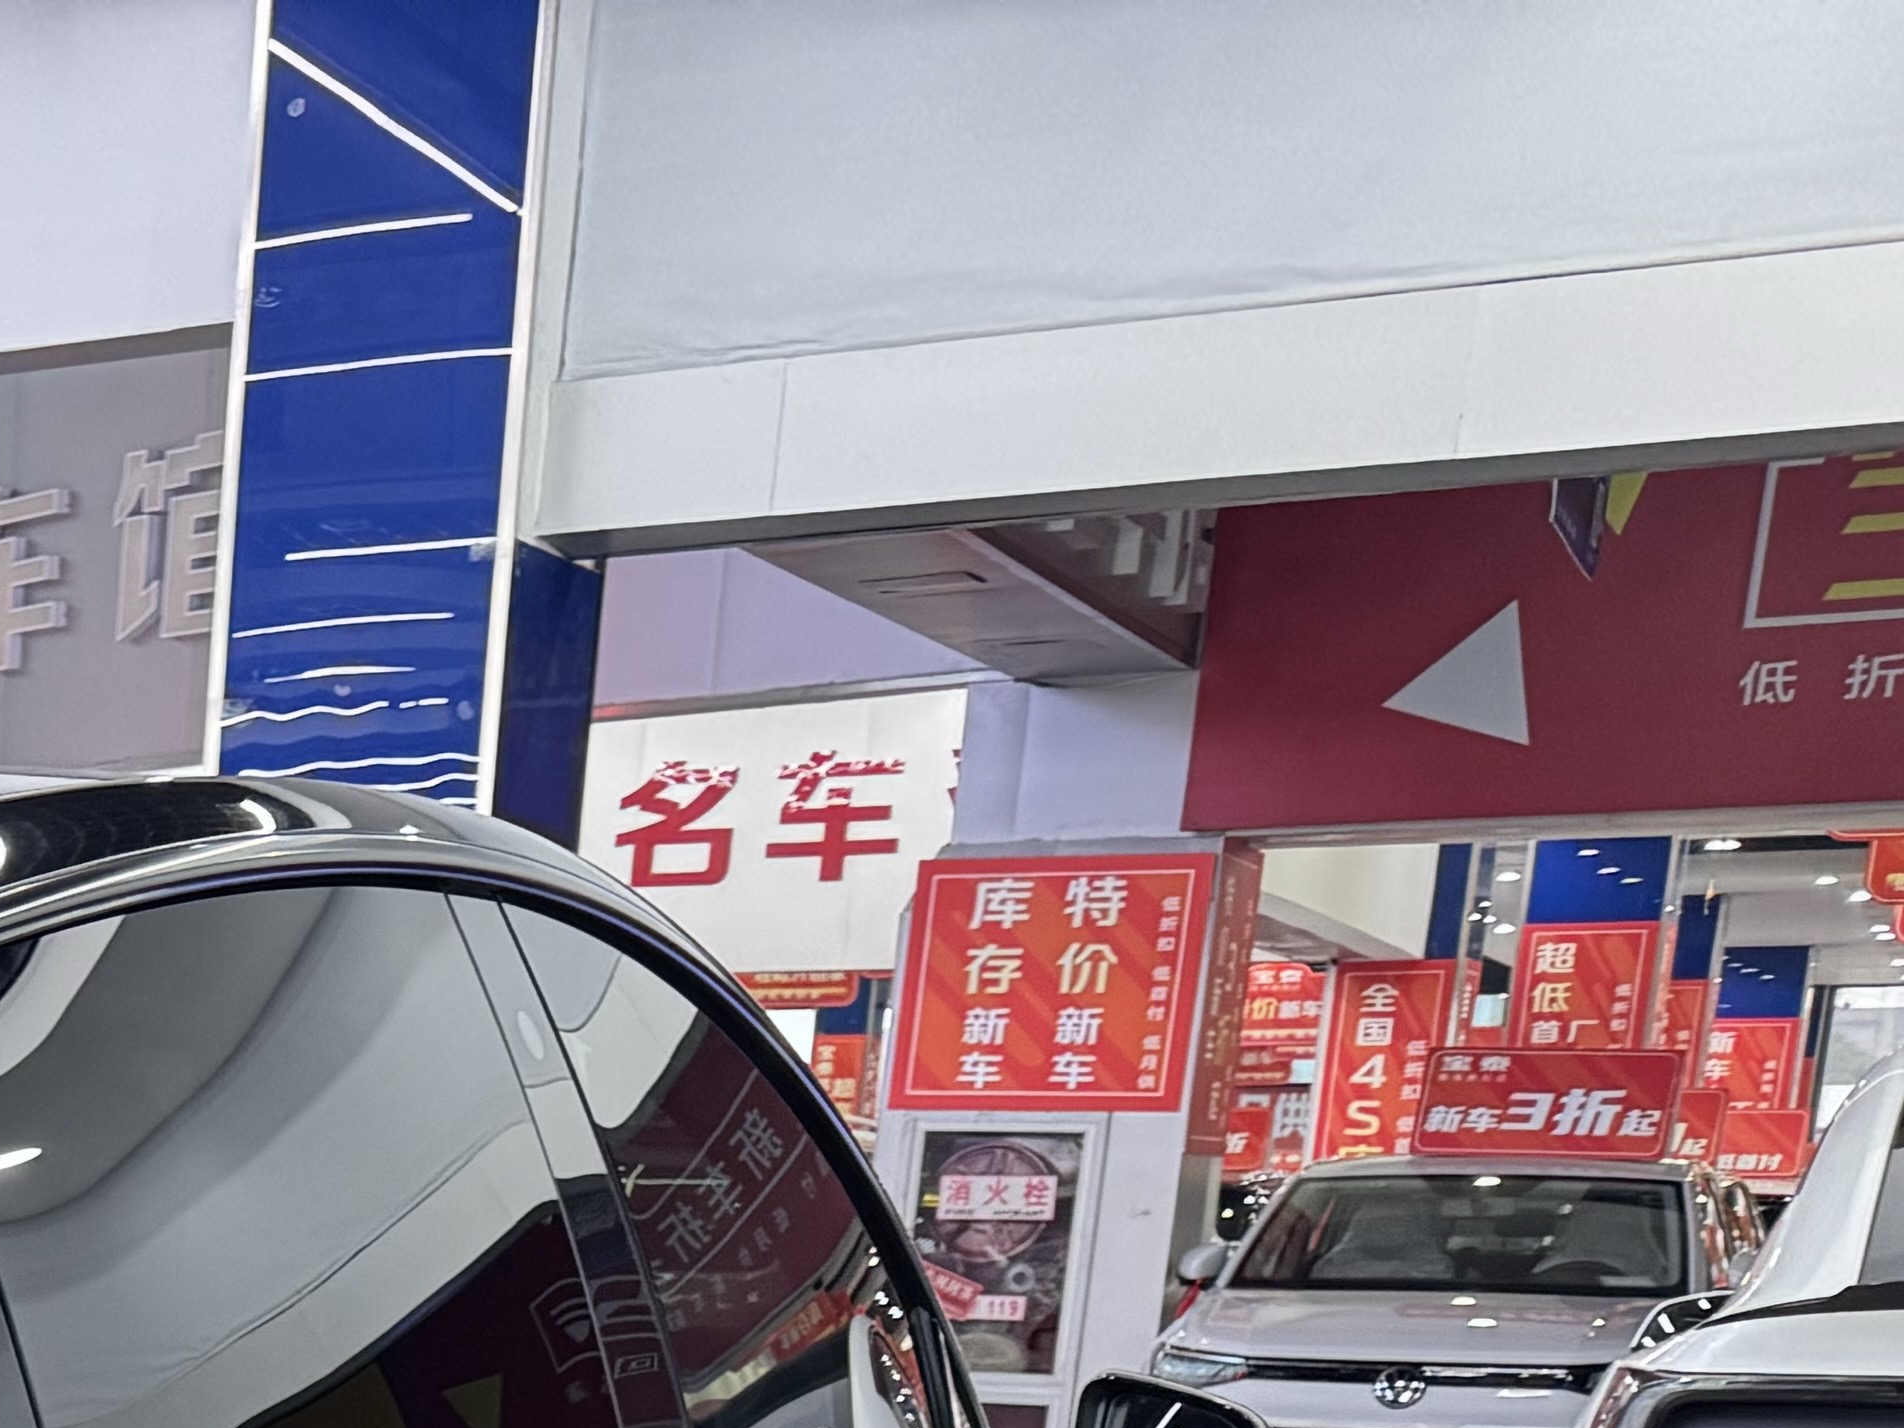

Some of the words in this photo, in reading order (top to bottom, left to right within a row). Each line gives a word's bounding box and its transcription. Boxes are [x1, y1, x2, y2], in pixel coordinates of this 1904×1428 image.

[615, 748, 962, 887] 名车
[955, 878, 1035, 1090] 库存新车
[1048, 876, 1128, 1090] 特价新车
[1423, 1088, 1662, 1136] 新车3折起
[947, 1177, 1051, 1207] 消火栓
